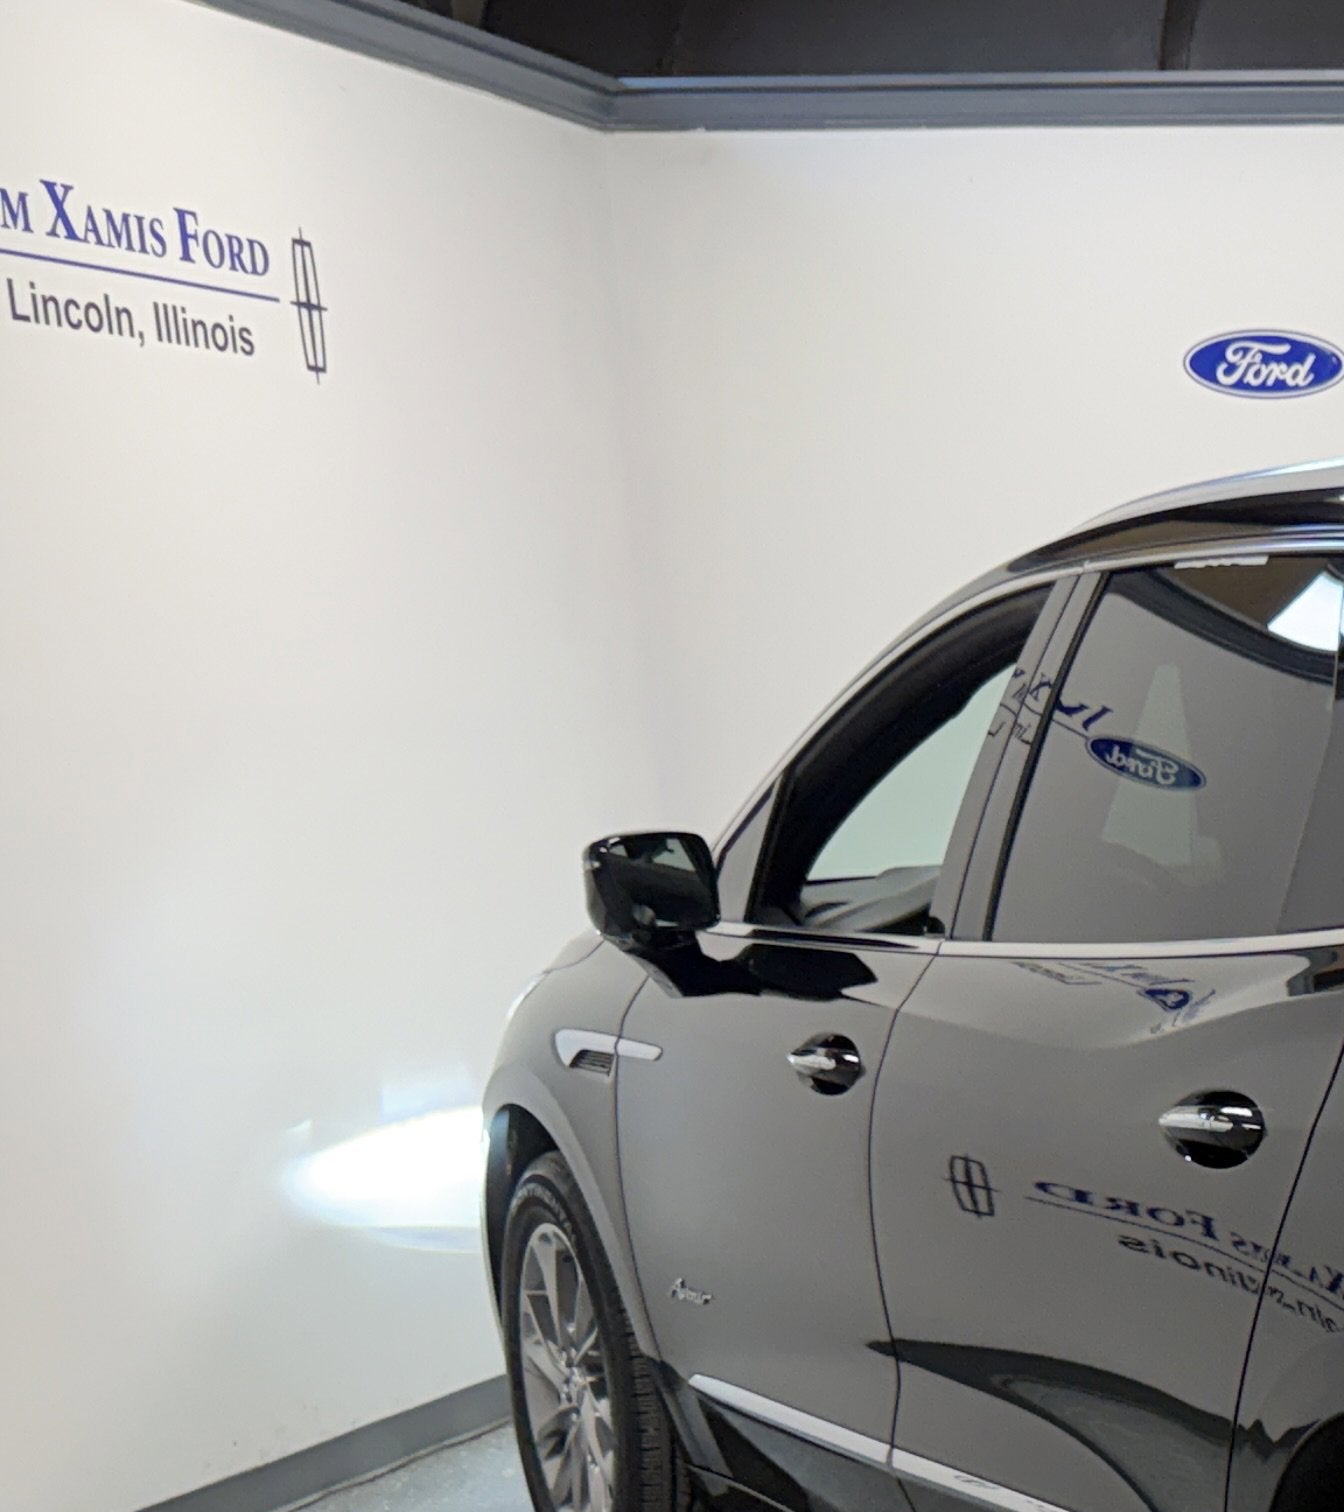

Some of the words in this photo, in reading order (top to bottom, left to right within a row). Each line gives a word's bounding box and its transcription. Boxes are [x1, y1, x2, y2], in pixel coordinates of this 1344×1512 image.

[6, 277, 146, 348] Lincoln,
[152, 301, 256, 357] Illinois
[1214, 340, 1316, 389] Ford
